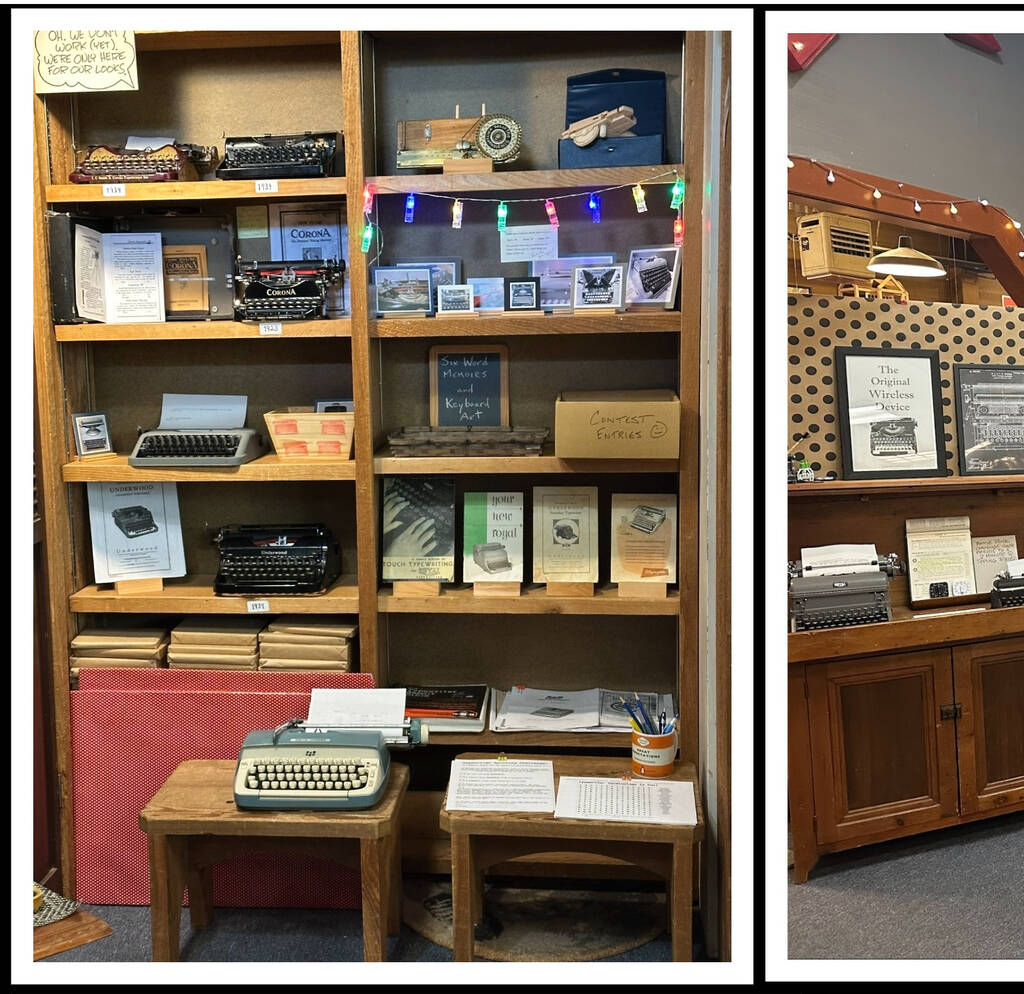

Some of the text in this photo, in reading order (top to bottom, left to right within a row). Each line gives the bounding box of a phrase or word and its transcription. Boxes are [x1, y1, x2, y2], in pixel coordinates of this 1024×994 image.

[55, 42, 86, 52] WORK
[74, 54, 96, 63] ONLY
[100, 51, 126, 62] HERE
[48, 65, 68, 75] FOR
[70, 64, 92, 74] OUR
[290, 228, 331, 238] CORONA
[266, 288, 296, 296] CORONA
[878, 366, 899, 375] The
[871, 377, 911, 388] Original
[457, 385, 474, 393] and
[869, 390, 914, 400] Wireless
[445, 398, 490, 413] Keyboard
[459, 410, 483, 421] Art
